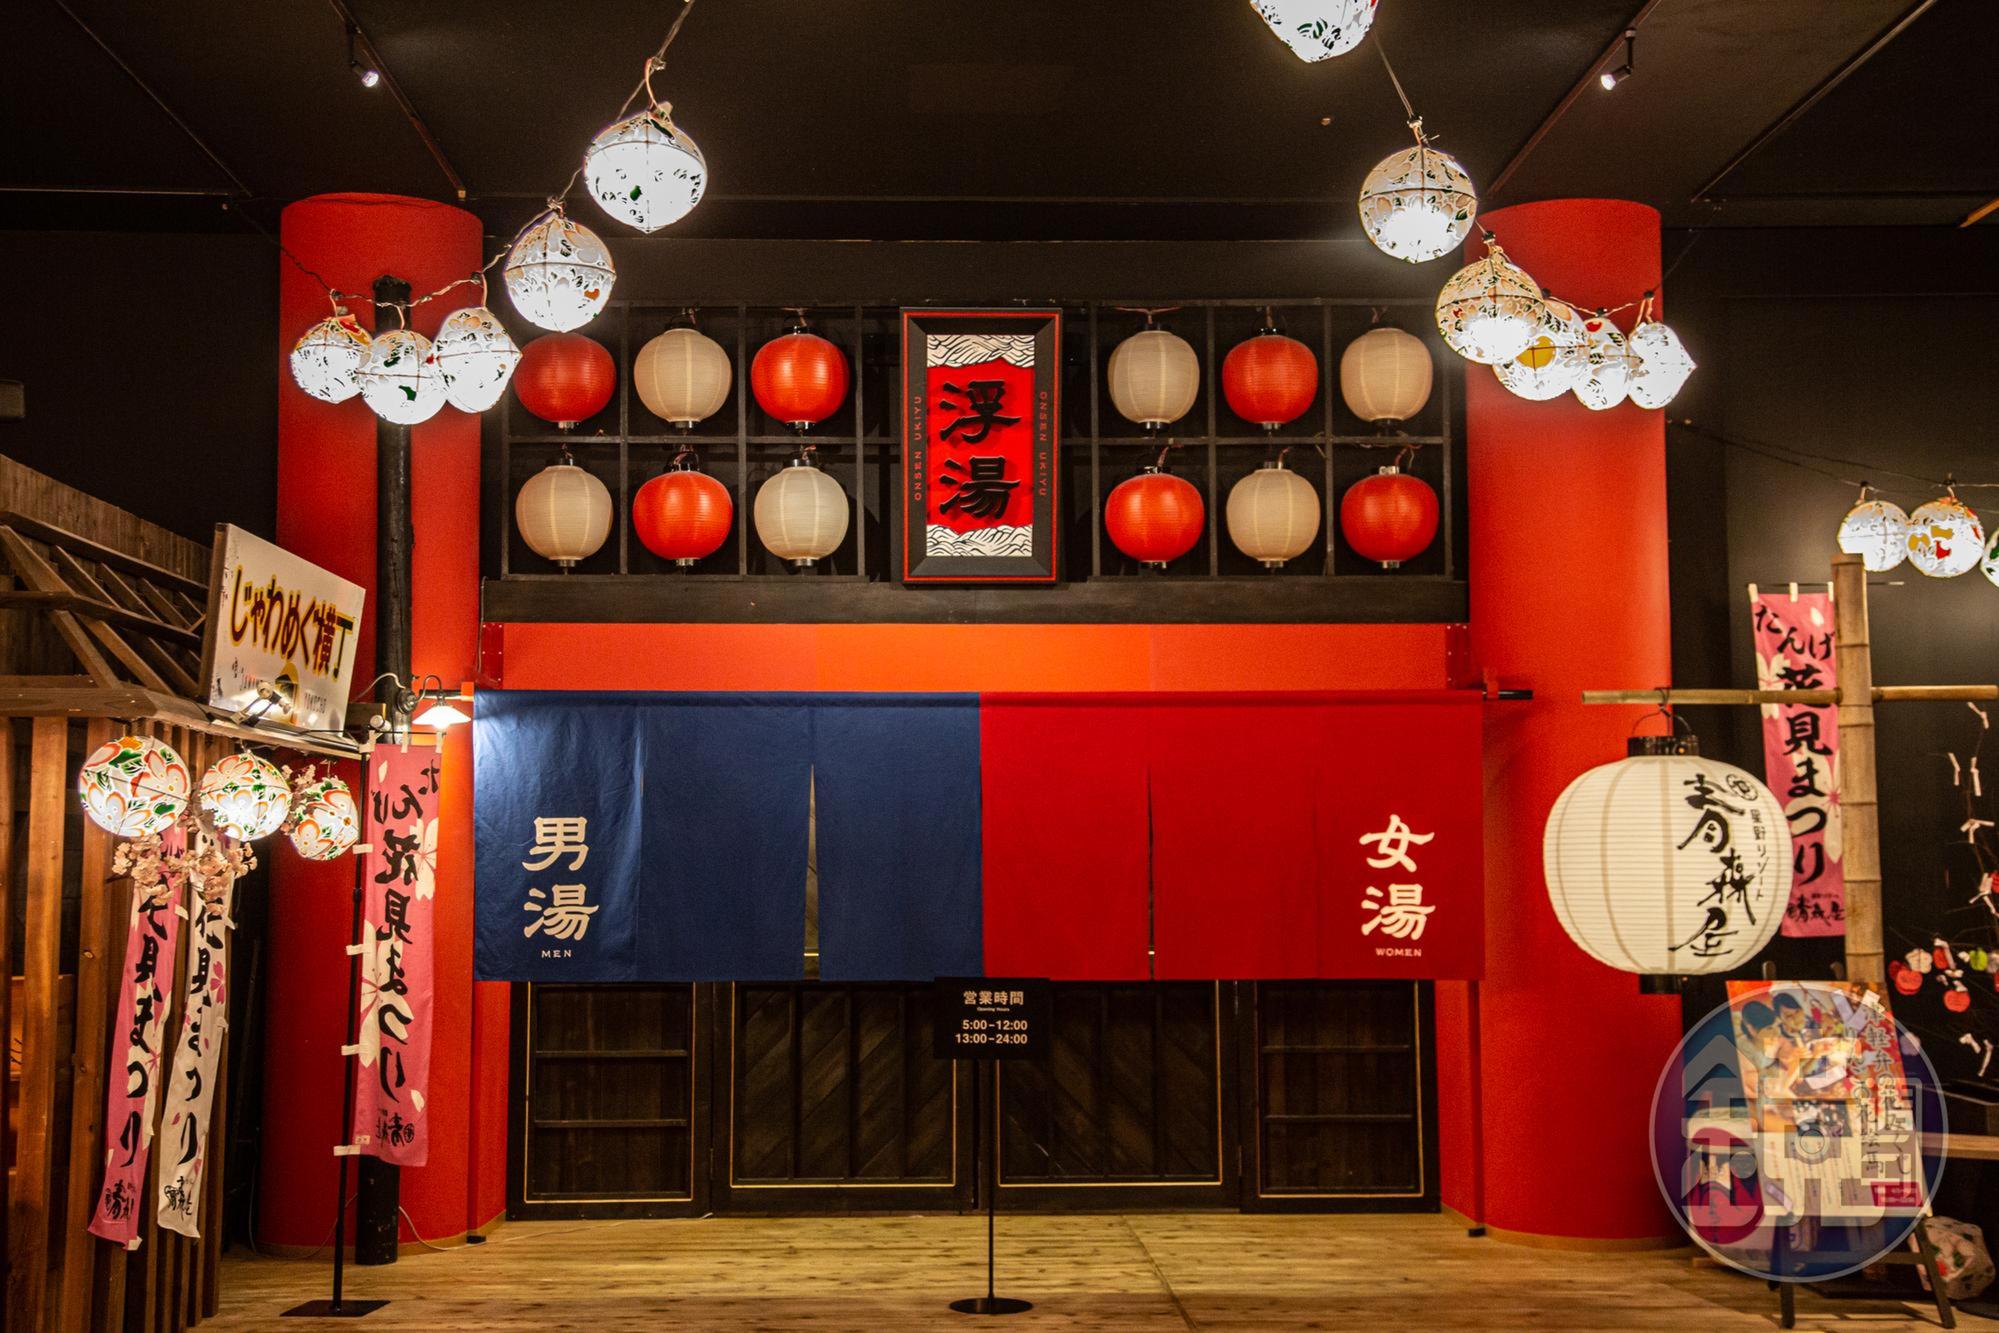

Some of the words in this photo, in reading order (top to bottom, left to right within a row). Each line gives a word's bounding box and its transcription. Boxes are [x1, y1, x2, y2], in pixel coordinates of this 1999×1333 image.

[913, 395, 923, 442] UKIYU
[1038, 391, 1048, 442] ONSEN
[938, 379, 1022, 520] 浮湯
[913, 452, 923, 501] ONSEN
[1038, 452, 1047, 497] UKIYU
[522, 816, 600, 941] 男湯
[1359, 814, 1436, 940] 女湯
[541, 949, 572, 959] MEN
[1375, 948, 1422, 957] WOMEN
[963, 990, 1024, 1005] 営業時間
